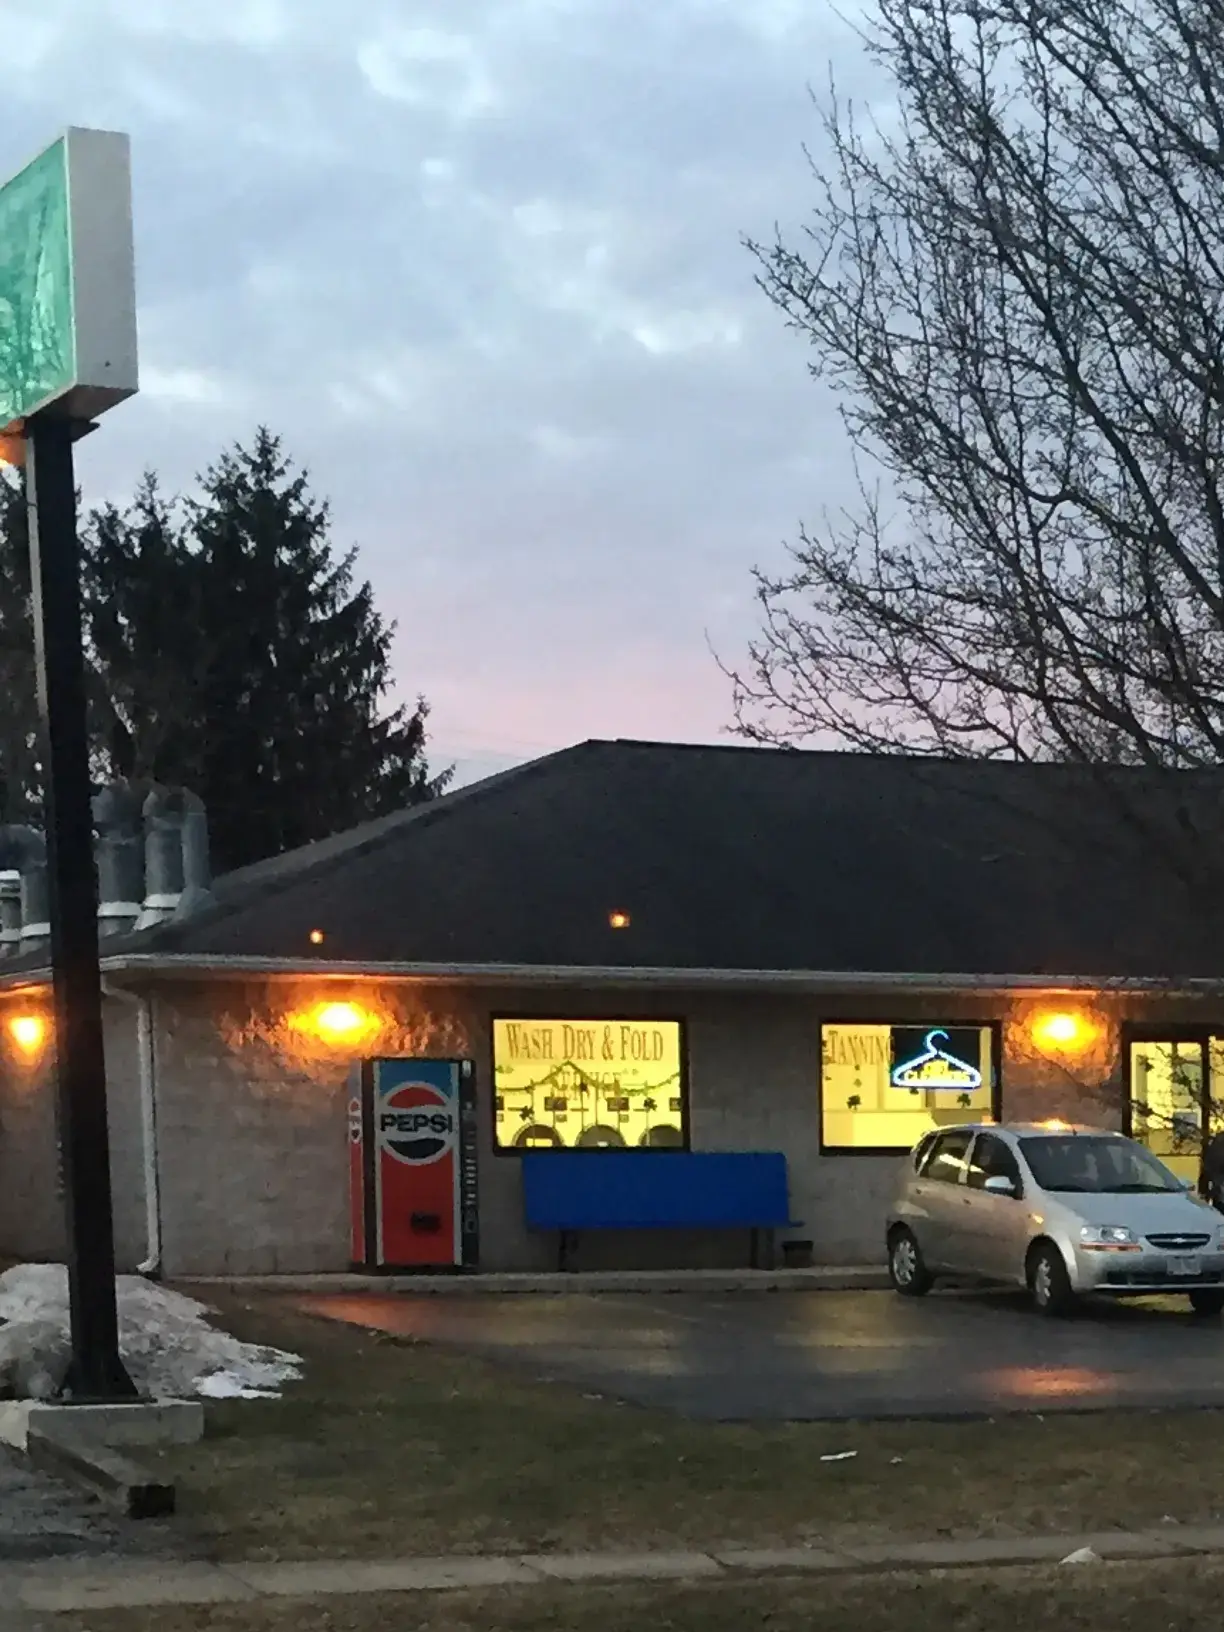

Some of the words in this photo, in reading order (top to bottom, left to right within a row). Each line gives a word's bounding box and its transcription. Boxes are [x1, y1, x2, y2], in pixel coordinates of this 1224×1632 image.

[505, 1023, 553, 1060] WASH
[562, 1024, 596, 1060] DRY
[602, 1025, 614, 1061] &
[620, 1026, 664, 1061] FOLD
[381, 1113, 453, 1133] PEPSI
